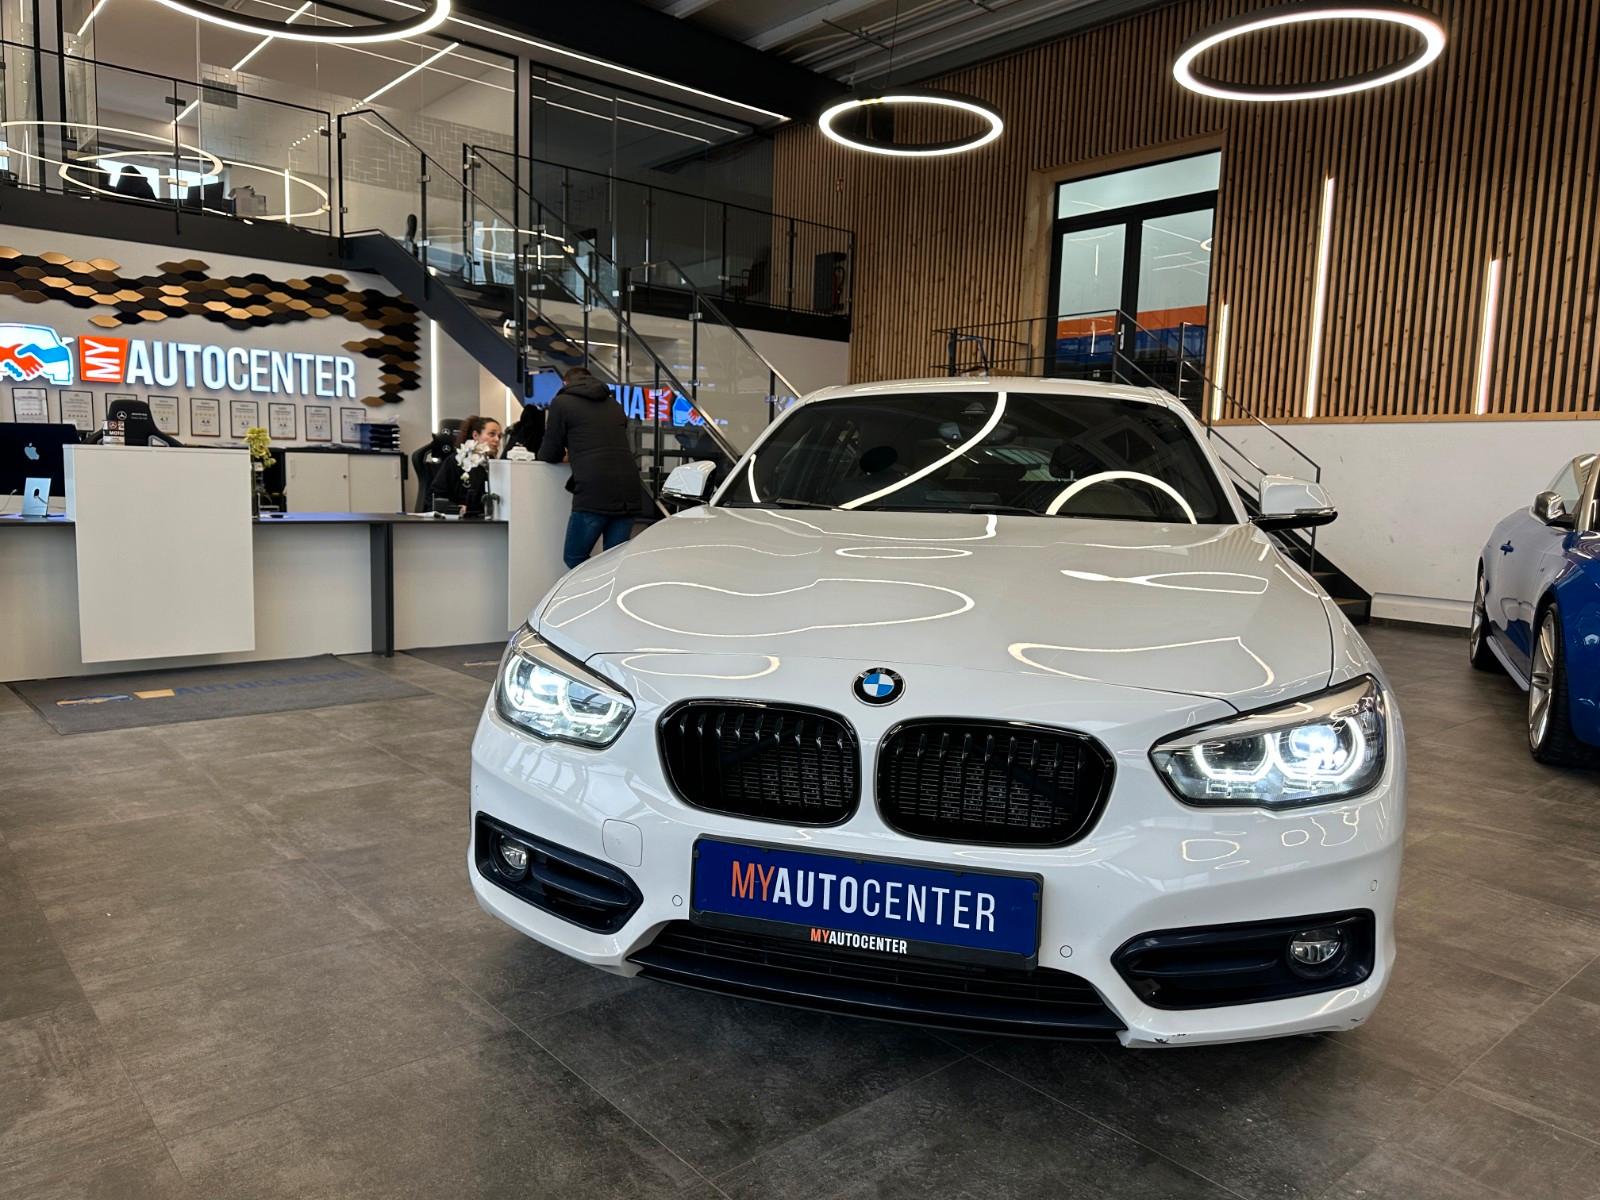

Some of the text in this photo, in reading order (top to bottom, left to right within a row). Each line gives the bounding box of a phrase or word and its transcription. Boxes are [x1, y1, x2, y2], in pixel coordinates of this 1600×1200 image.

[85, 339, 356, 398] MY AUTOCENTER
[731, 860, 996, 932] MYAUTOCENTER
[810, 927, 907, 955] MYAUTOCENTER
